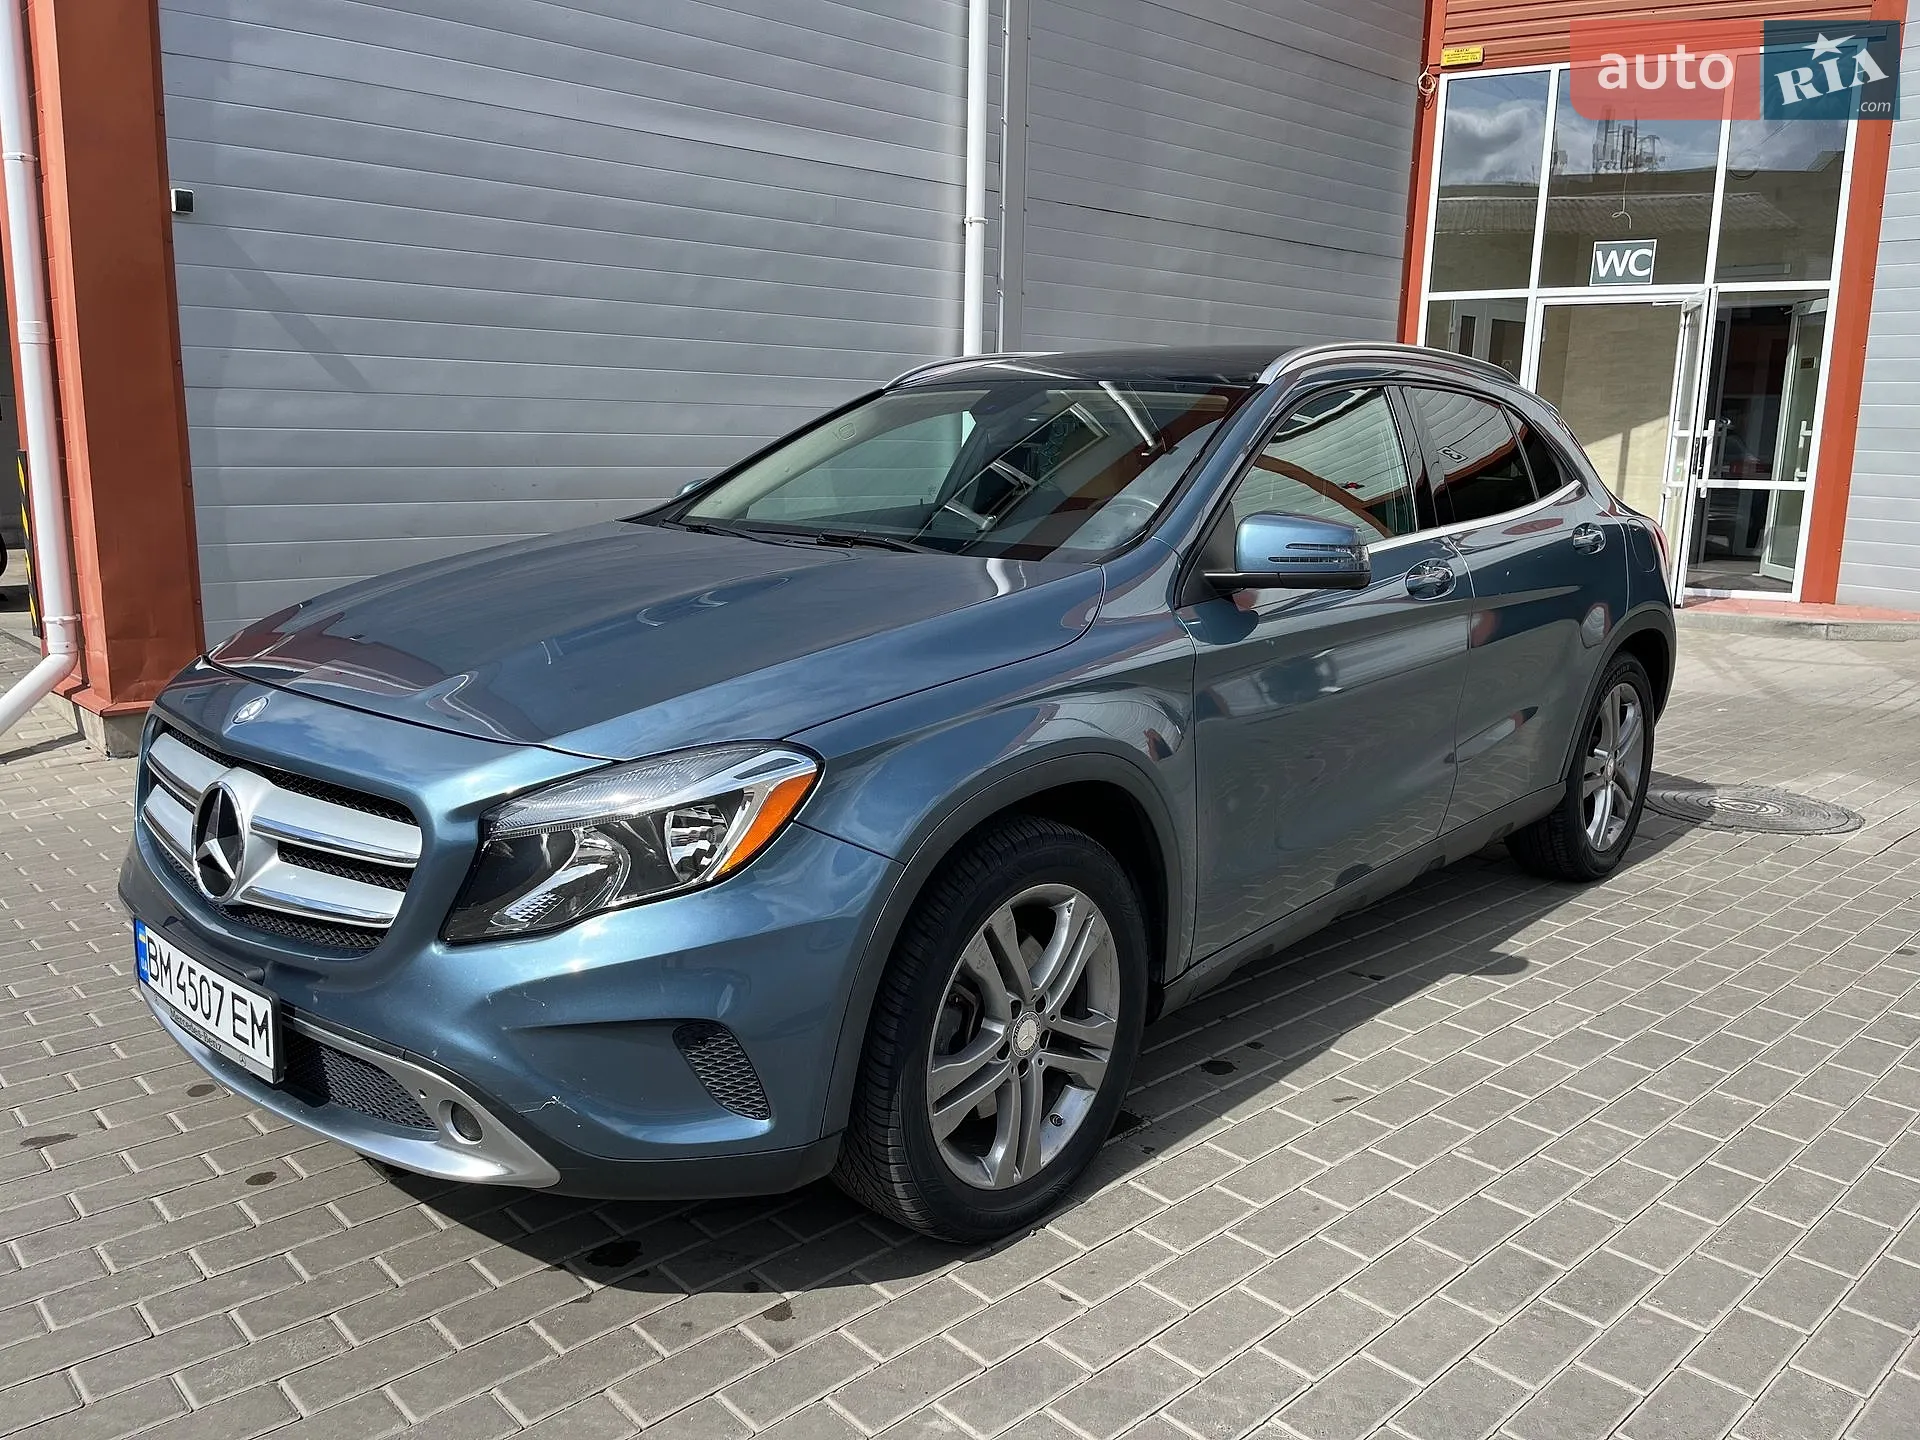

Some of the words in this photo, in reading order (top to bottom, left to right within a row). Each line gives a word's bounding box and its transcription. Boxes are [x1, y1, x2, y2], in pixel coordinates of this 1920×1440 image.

[1595, 248, 1653, 278] WC
[147, 935, 173, 995] BM
[176, 961, 225, 1027] 4507
[231, 991, 270, 1057] EM
